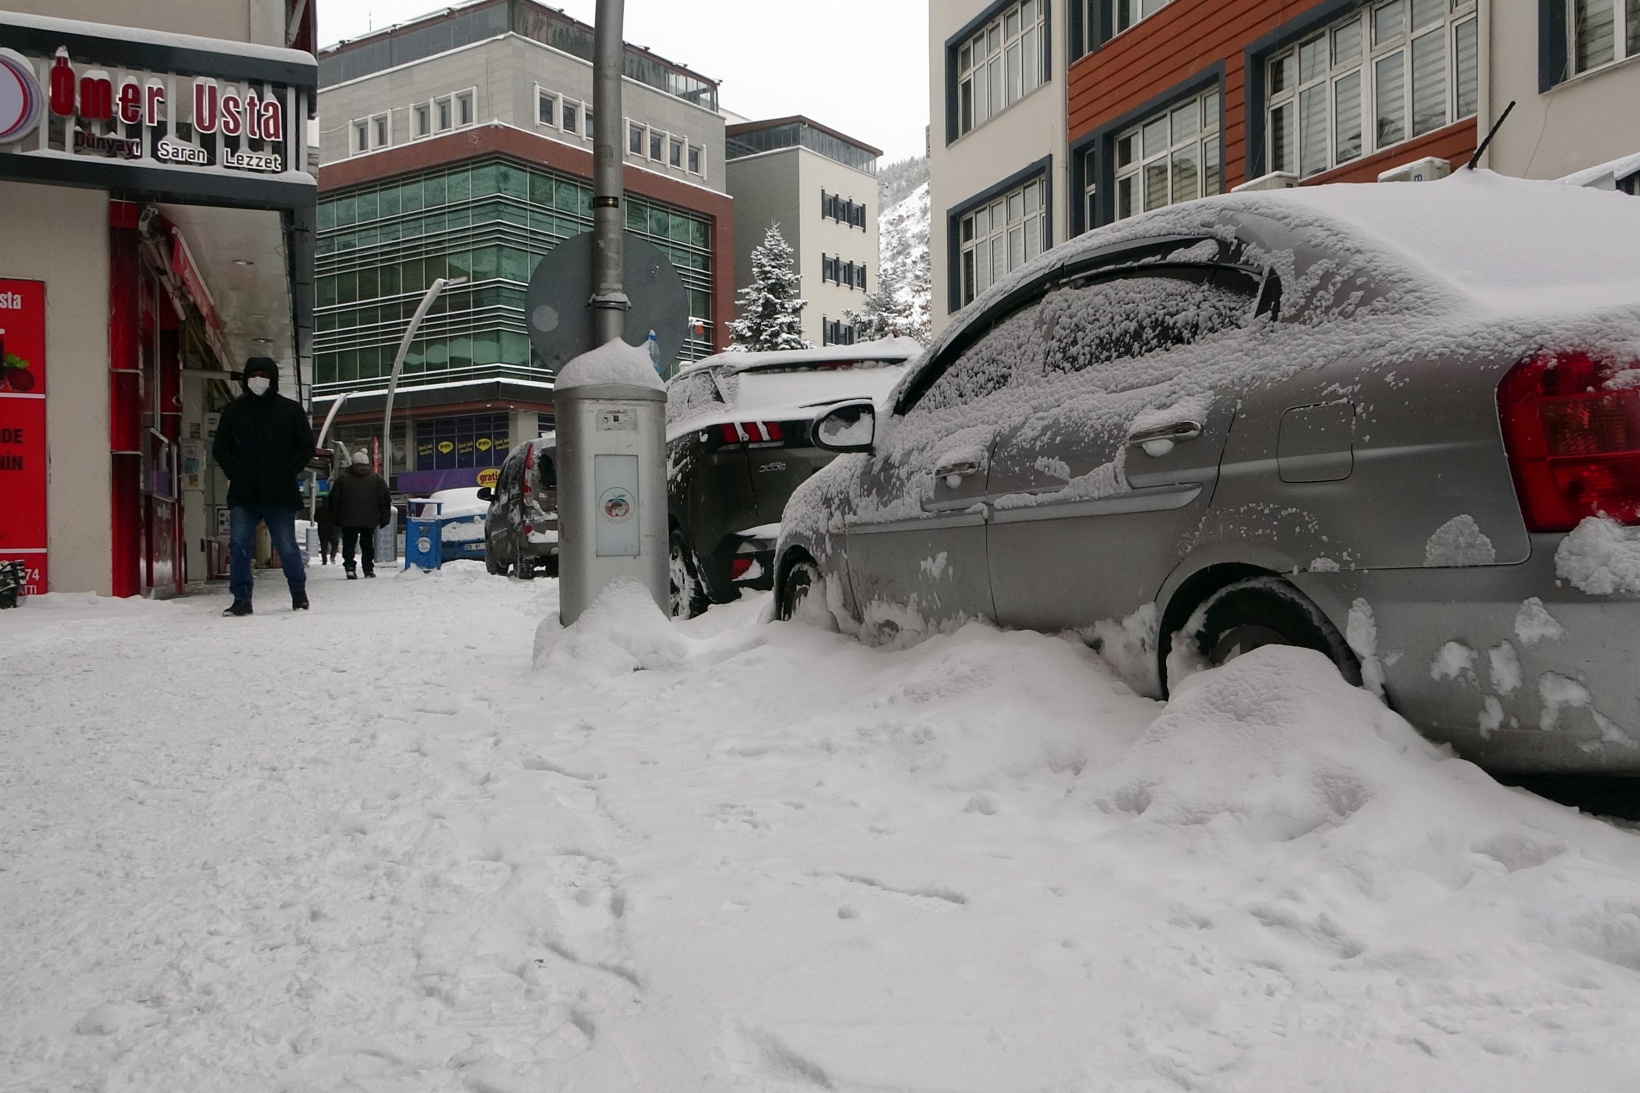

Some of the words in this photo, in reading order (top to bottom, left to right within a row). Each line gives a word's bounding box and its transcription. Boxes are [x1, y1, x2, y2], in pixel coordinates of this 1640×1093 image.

[193, 77, 283, 142] Usta
[157, 138, 208, 164] Saran
[224, 147, 282, 172] Lezzet
[479, 471, 500, 484] grati
